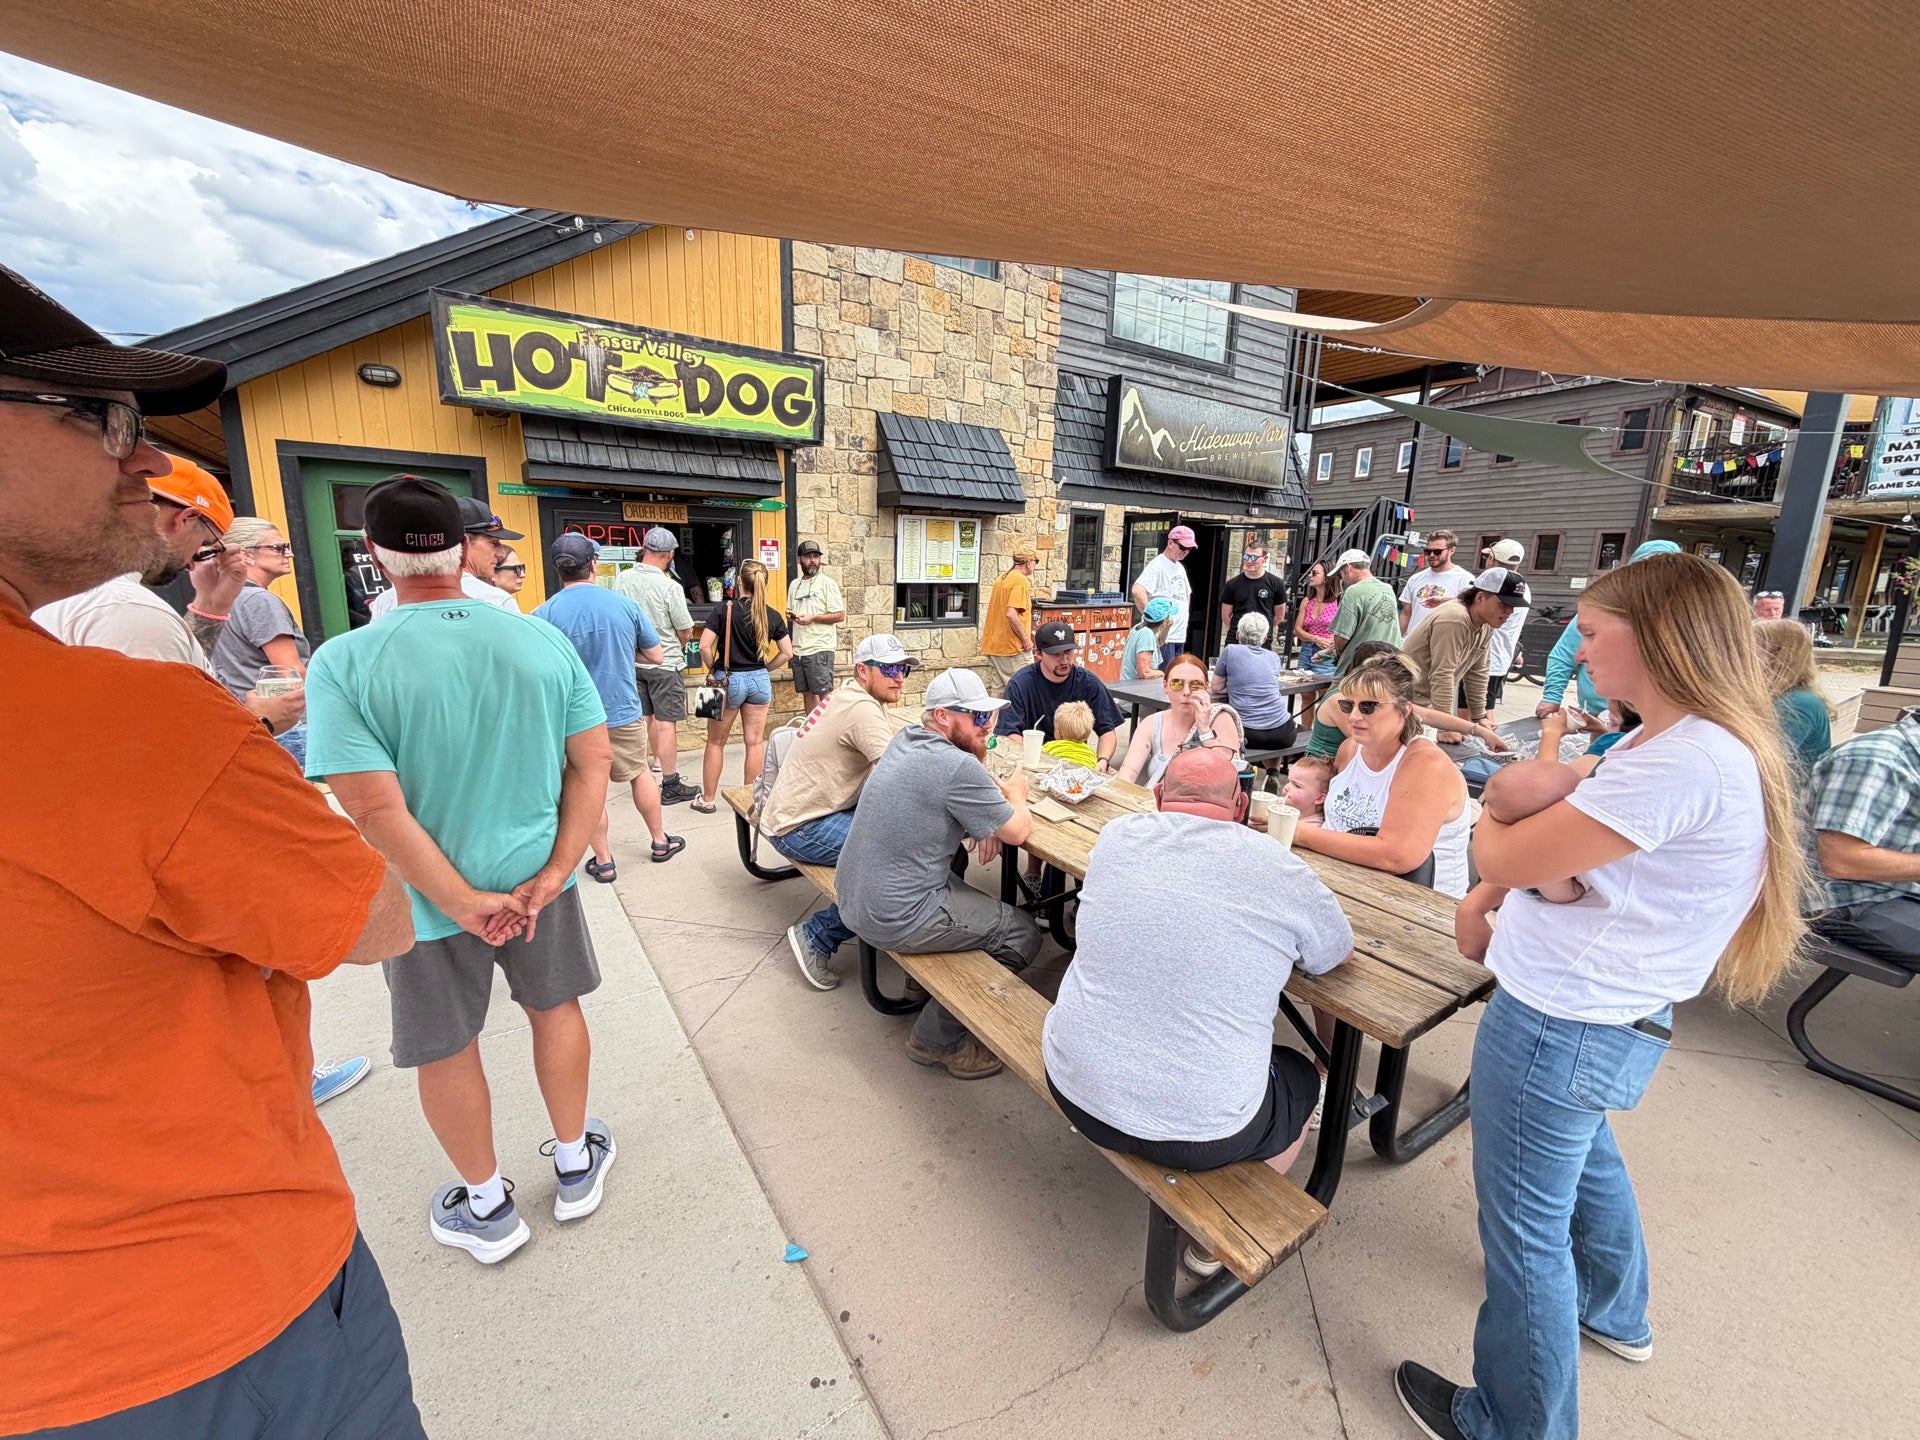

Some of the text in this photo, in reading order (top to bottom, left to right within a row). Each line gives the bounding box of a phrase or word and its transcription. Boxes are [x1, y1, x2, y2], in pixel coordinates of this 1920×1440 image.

[578, 331, 704, 368] Fraser Valley
[450, 330, 814, 427] HOT DOG
[643, 408, 663, 416] STYLE
[664, 410, 685, 418] DOGS
[1180, 416, 1287, 452] Hideaway Park
[1209, 451, 1259, 462] BREWERY
[1868, 482, 1904, 491] GAME
[702, 499, 763, 508] DYNASTAR
[624, 504, 686, 520] ORDER HERE
[1072, 614, 1087, 624] YU
[1093, 613, 1129, 622] THANK YOU
